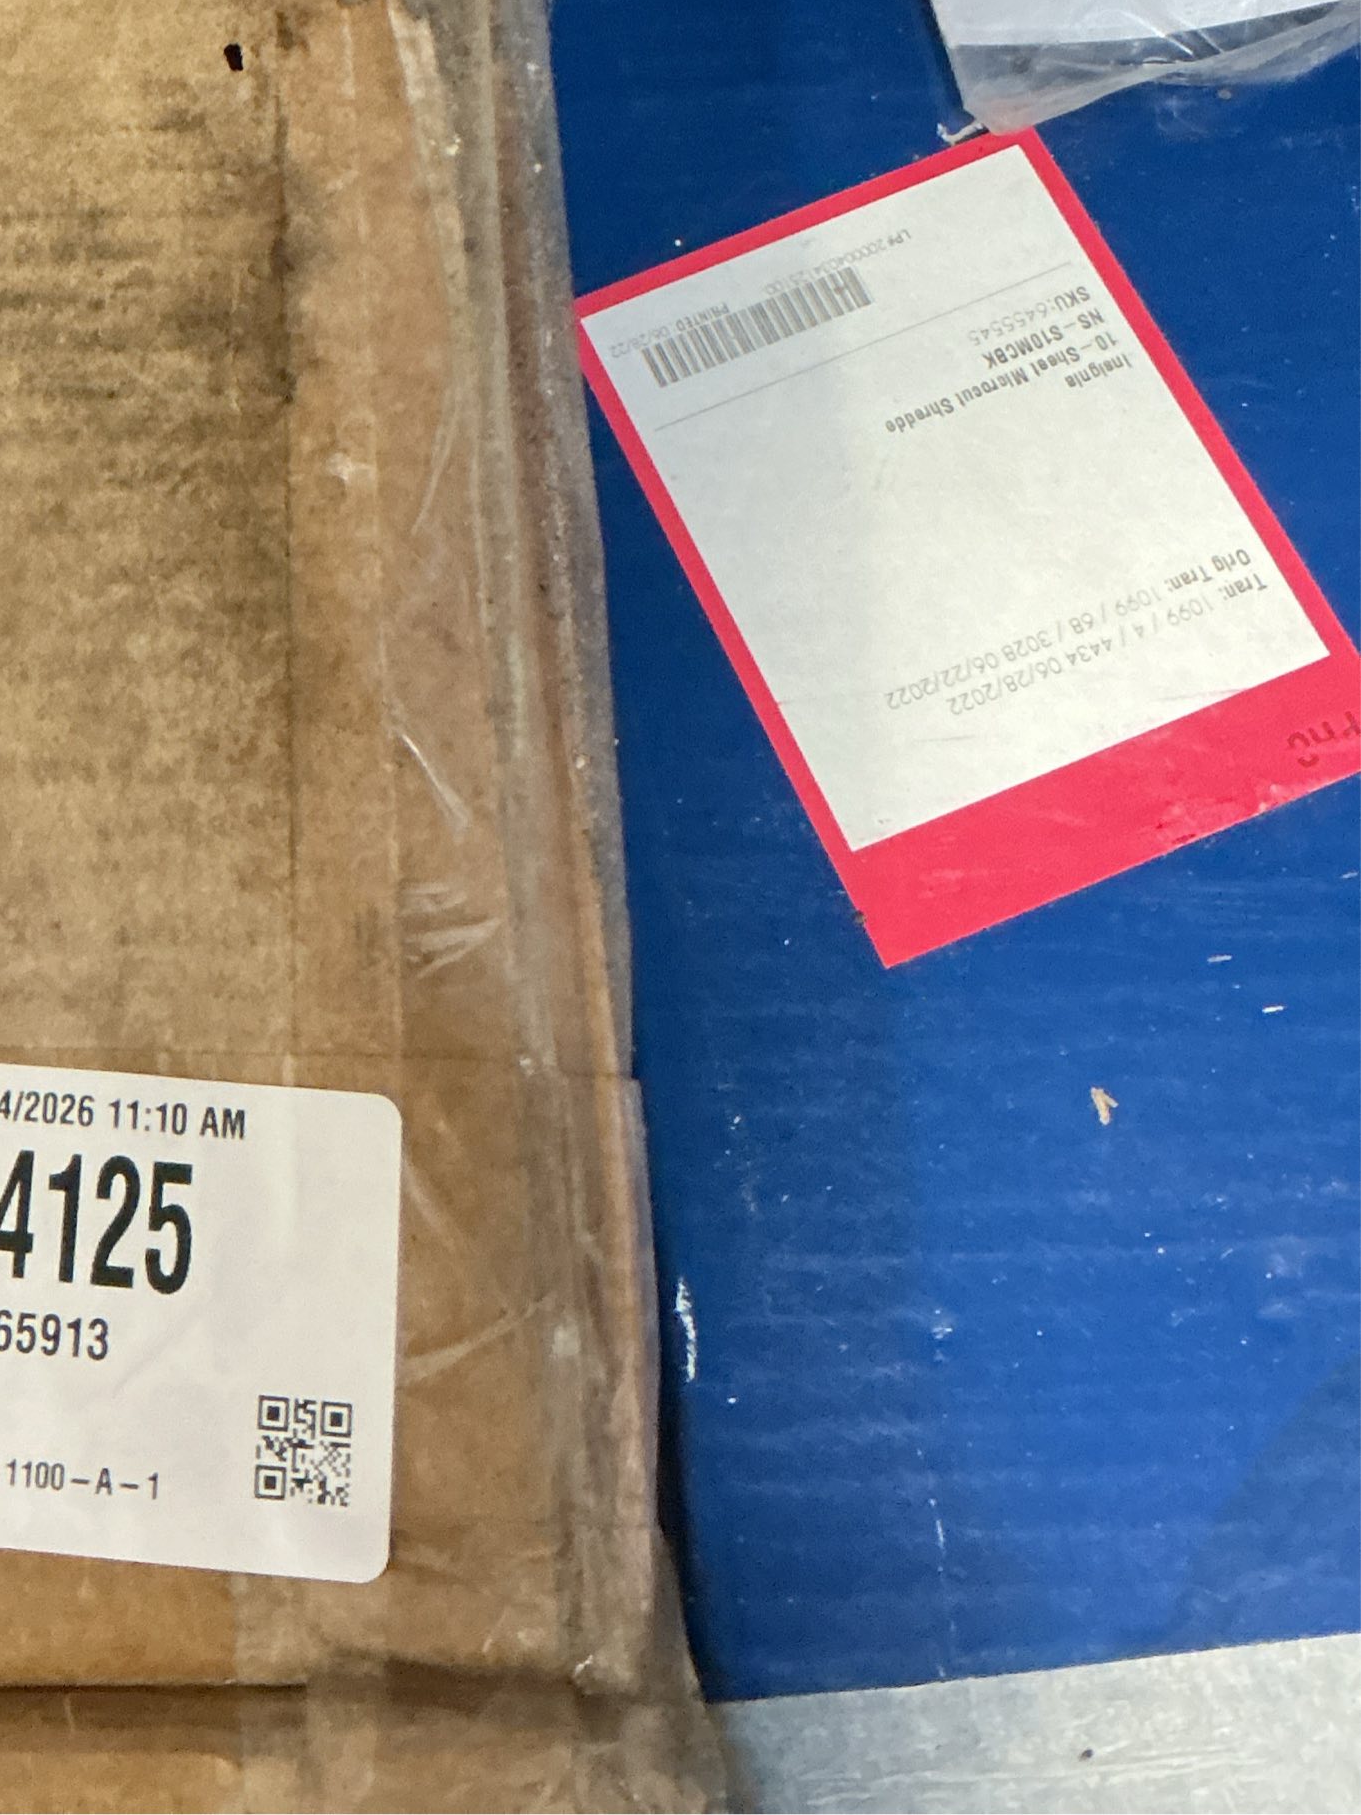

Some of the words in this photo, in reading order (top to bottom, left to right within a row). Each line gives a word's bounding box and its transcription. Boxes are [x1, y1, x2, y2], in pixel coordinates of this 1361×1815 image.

[967, 286, 1091, 347] SKU:6455545
[954, 369, 1029, 407] Microcut
[1064, 353, 1134, 389] Insignia
[885, 397, 954, 433] Shredde
[1163, 564, 1213, 591] Tran:
[1222, 572, 1268, 601] Tran:
[1115, 587, 1162, 617] 1099
[1166, 597, 1214, 627] 1099
[1068, 612, 1094, 635] 68
[1134, 621, 1145, 639] 4
[1002, 628, 1053, 663] 3028
[1066, 636, 1113, 667] 4434
[886, 651, 999, 711] 06/22/2022
[946, 656, 1062, 716] 06/28/2022
[108, 1100, 188, 1136] 11:10
[200, 1107, 246, 1140] AM
